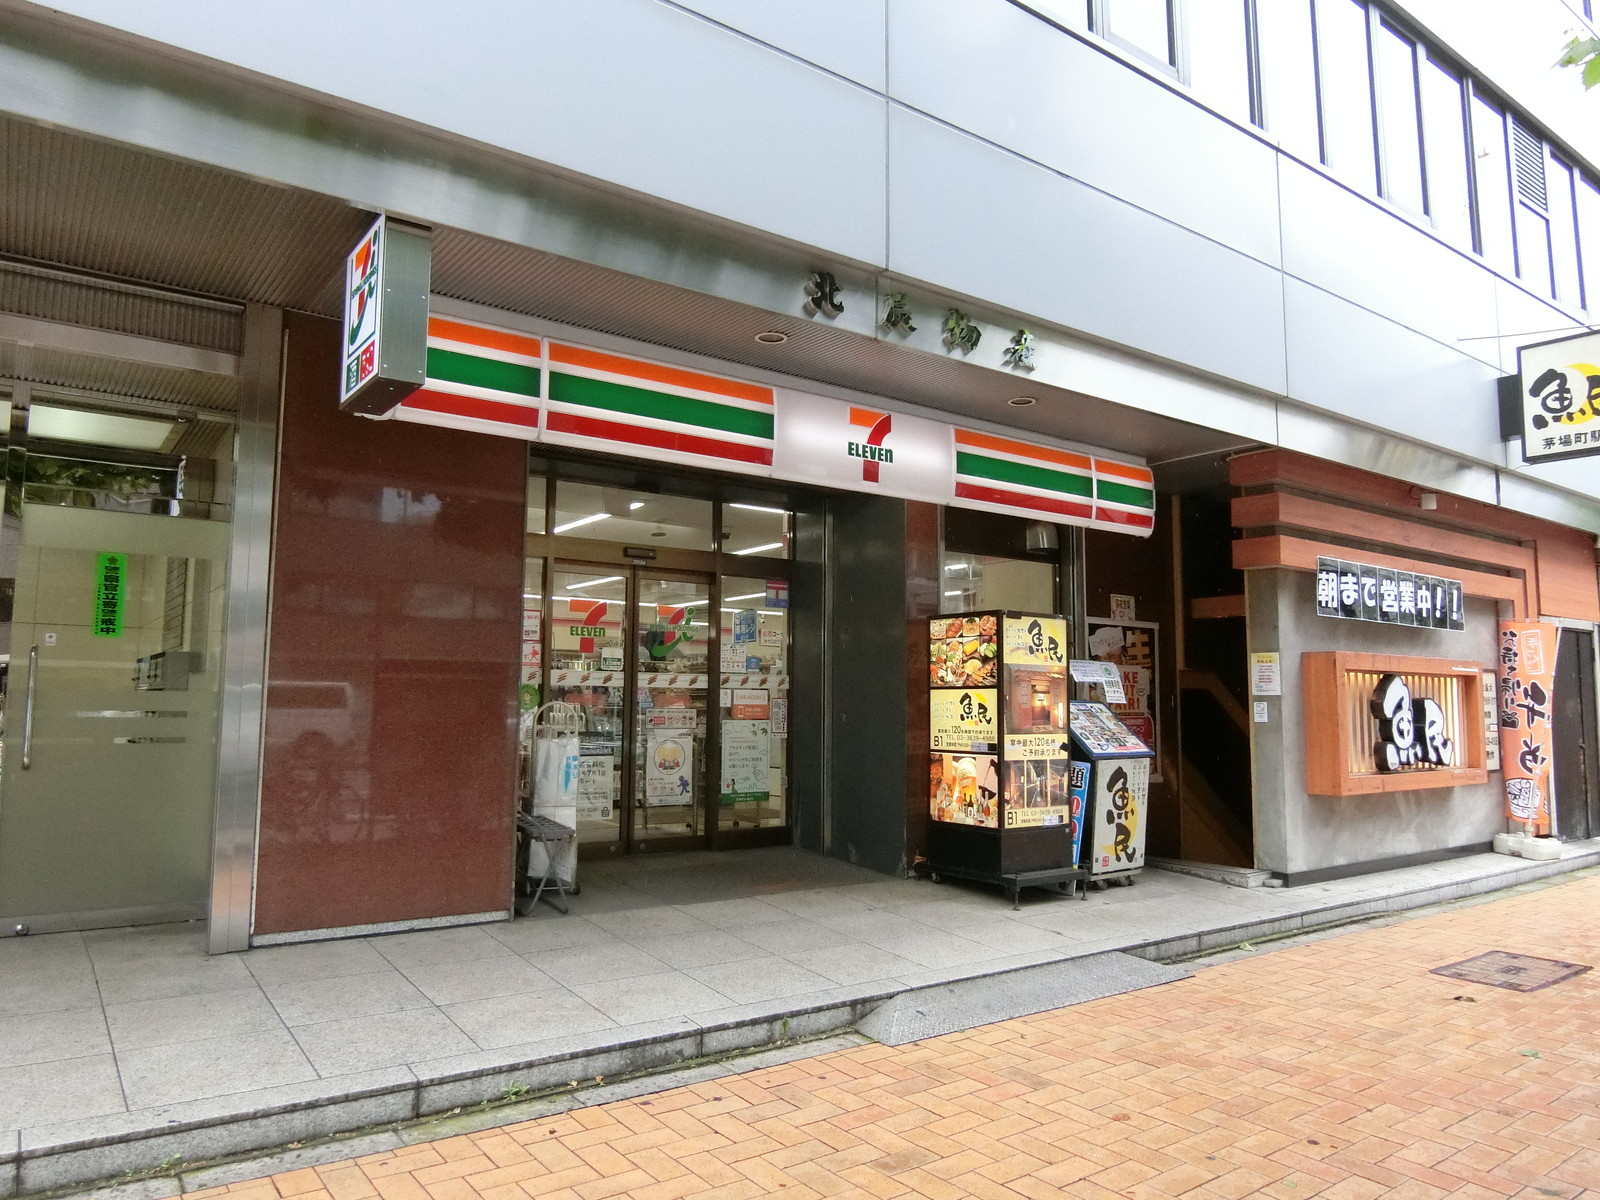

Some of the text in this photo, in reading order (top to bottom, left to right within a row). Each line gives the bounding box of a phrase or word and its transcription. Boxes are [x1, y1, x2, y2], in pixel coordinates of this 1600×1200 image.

[1028, 619, 1063, 663] 魚民
[959, 692, 992, 725] 魚民
[1383, 674, 1454, 771] 魚民
[933, 735, 944, 747] B1
[1007, 811, 1018, 826] B1
[1106, 766, 1137, 863] 魚民
